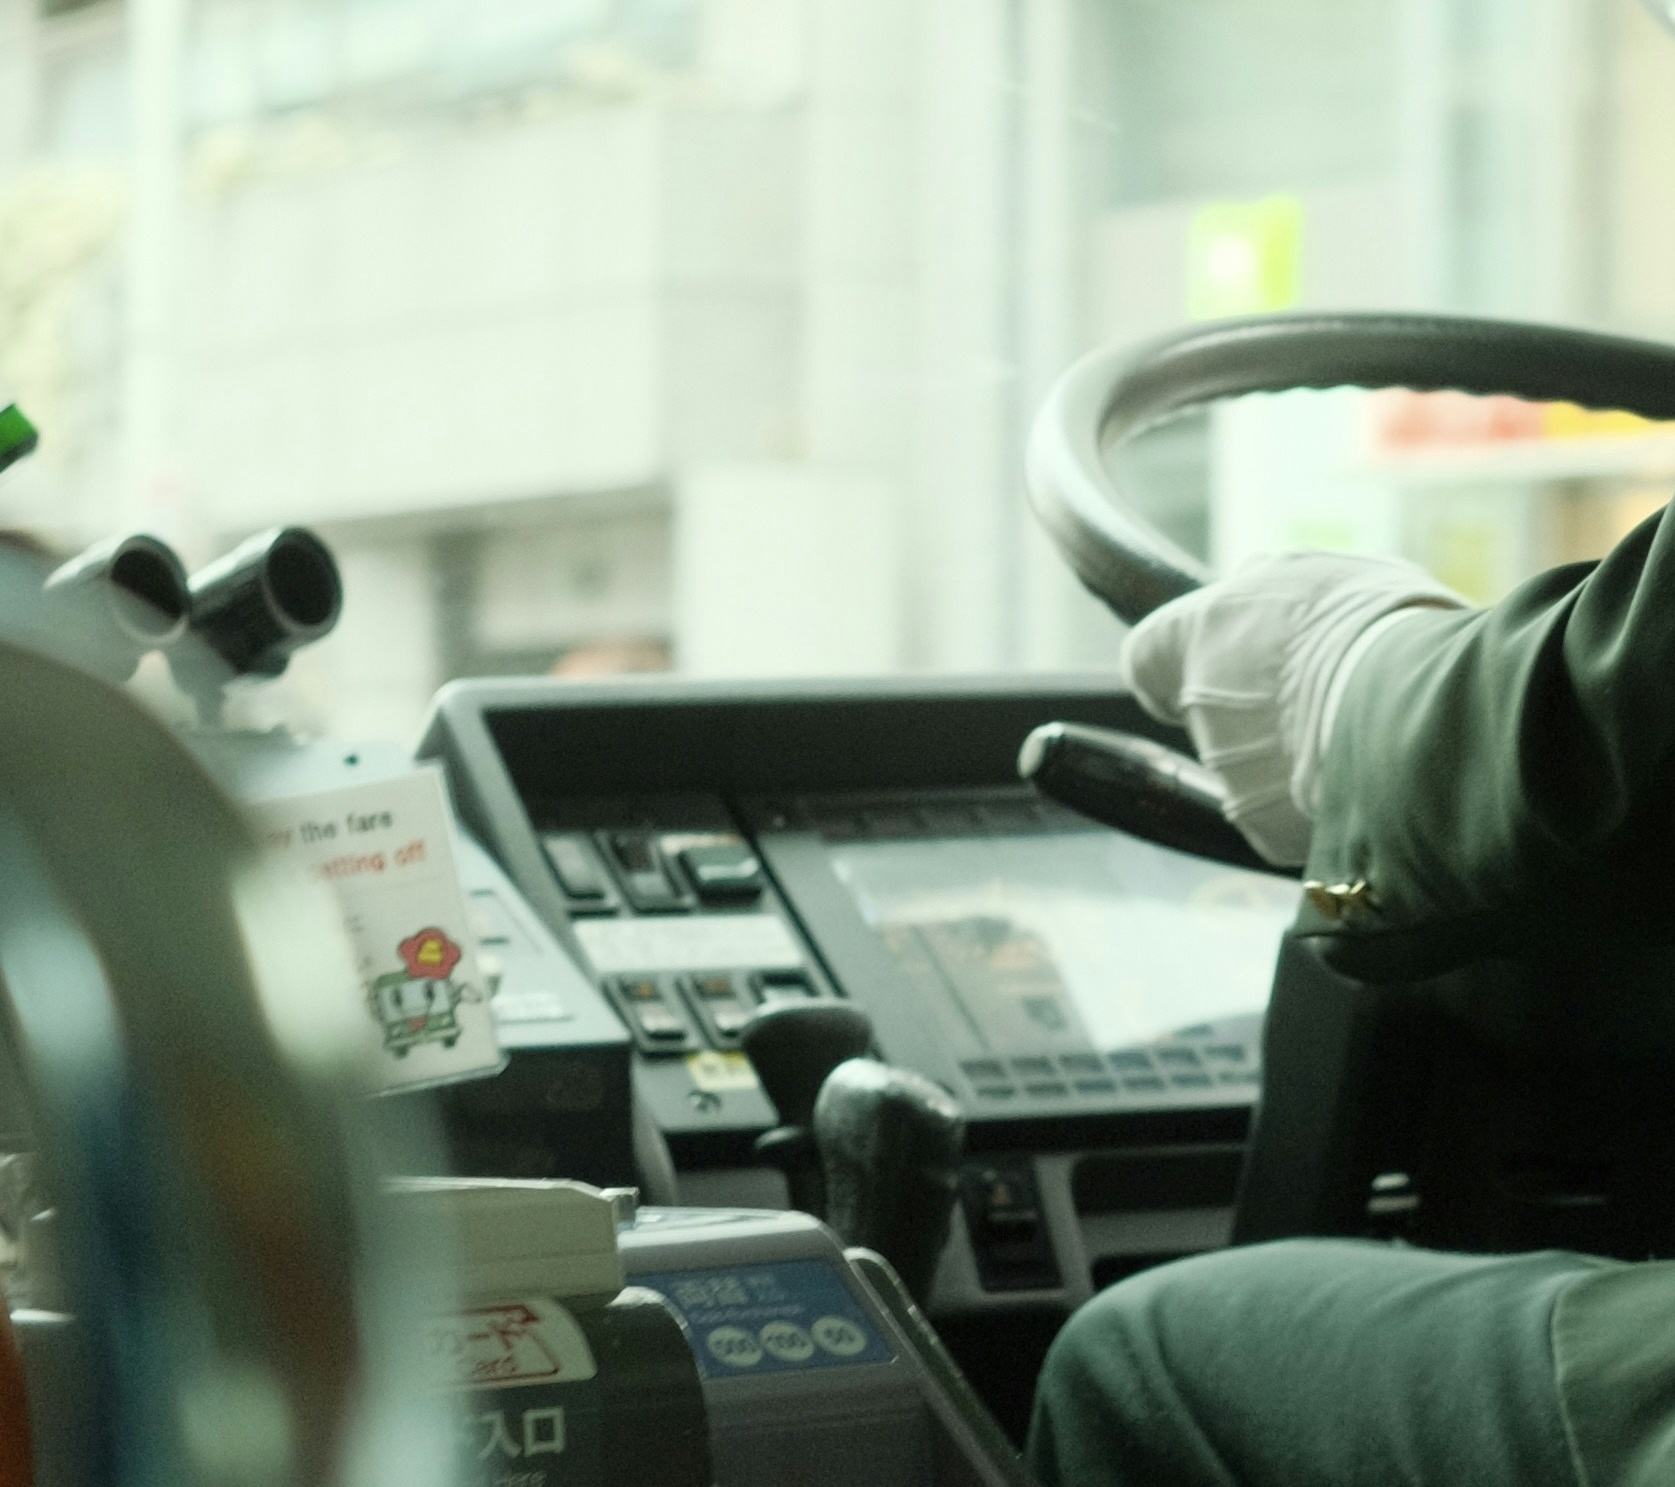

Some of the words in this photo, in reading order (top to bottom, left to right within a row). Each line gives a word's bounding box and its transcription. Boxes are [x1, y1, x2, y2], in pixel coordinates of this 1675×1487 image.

[299, 819, 338, 844] the
[345, 810, 394, 834] fare
[310, 850, 387, 880] etting
[394, 838, 426, 867] off
